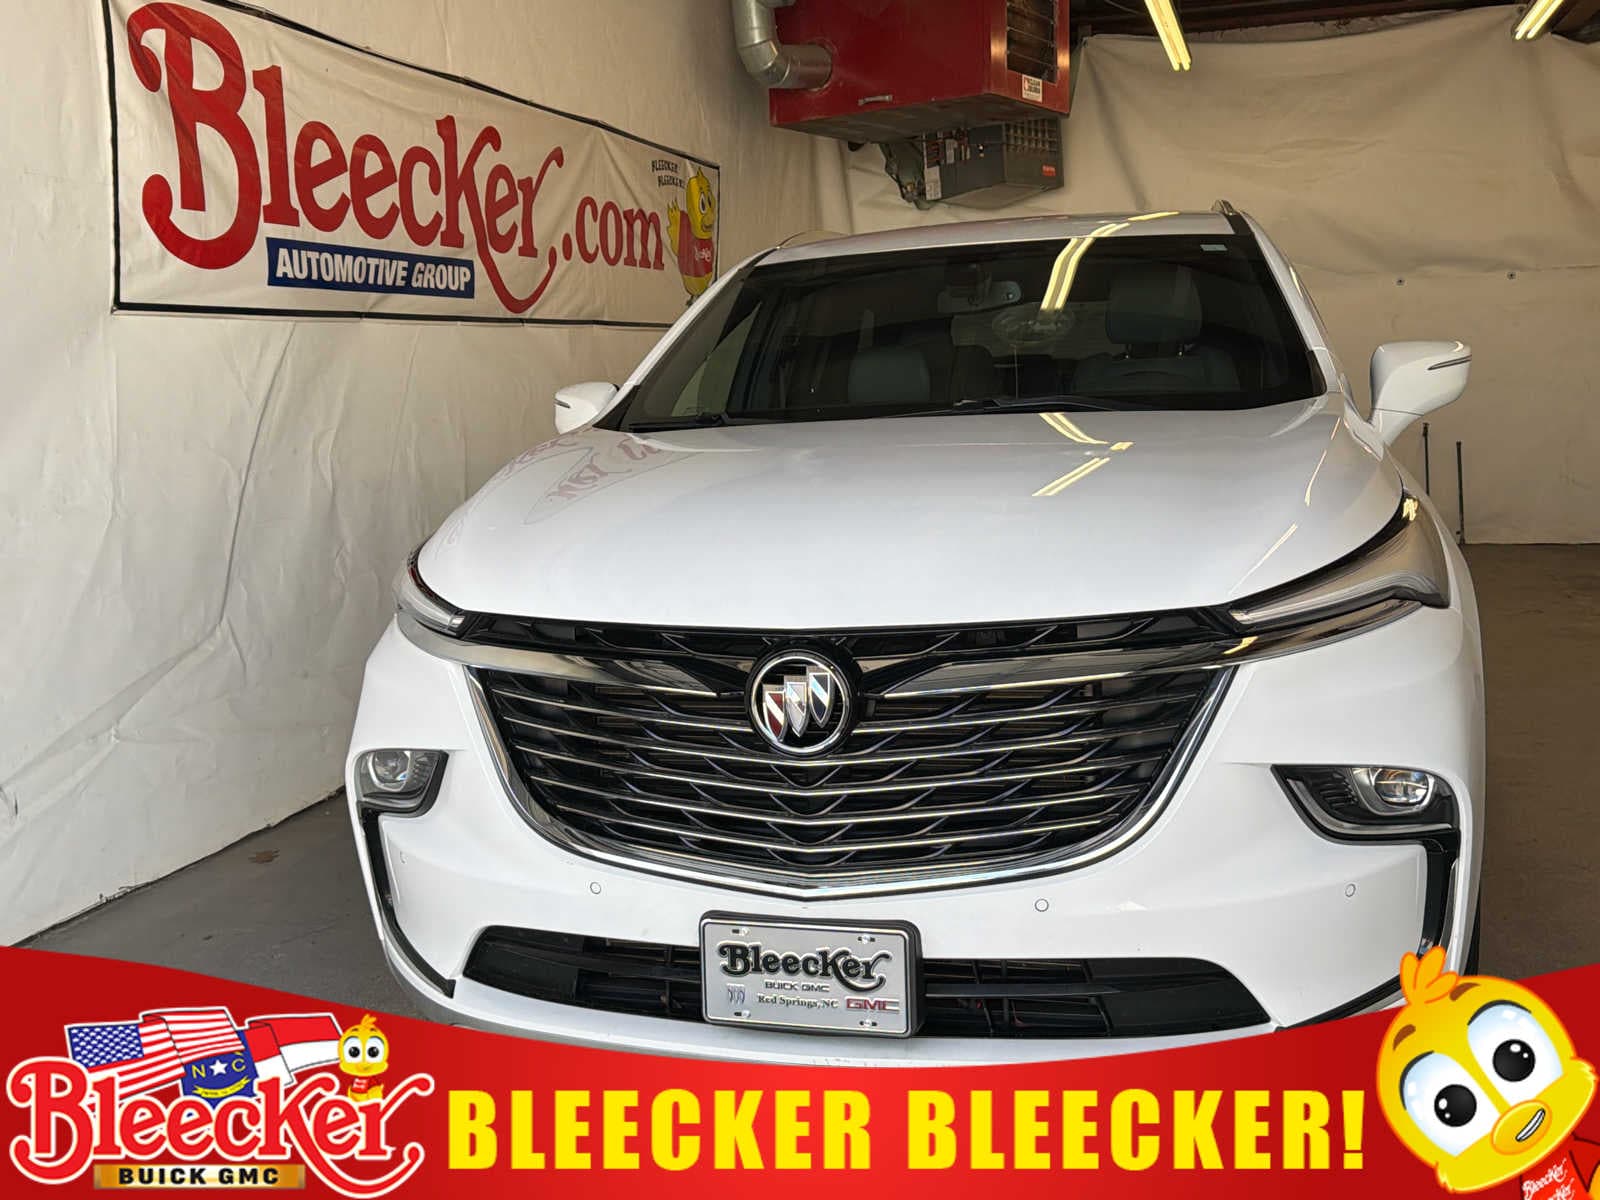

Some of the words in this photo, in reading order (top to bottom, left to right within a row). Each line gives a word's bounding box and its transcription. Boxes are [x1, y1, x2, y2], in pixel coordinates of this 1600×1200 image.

[276, 247, 409, 287] AUTOMOTIVE
[411, 262, 472, 292] GROUP
[764, 980, 798, 991] BUICK
[801, 984, 830, 993] GMC
[757, 994, 778, 1005] Red
[845, 998, 901, 1012] GMC
